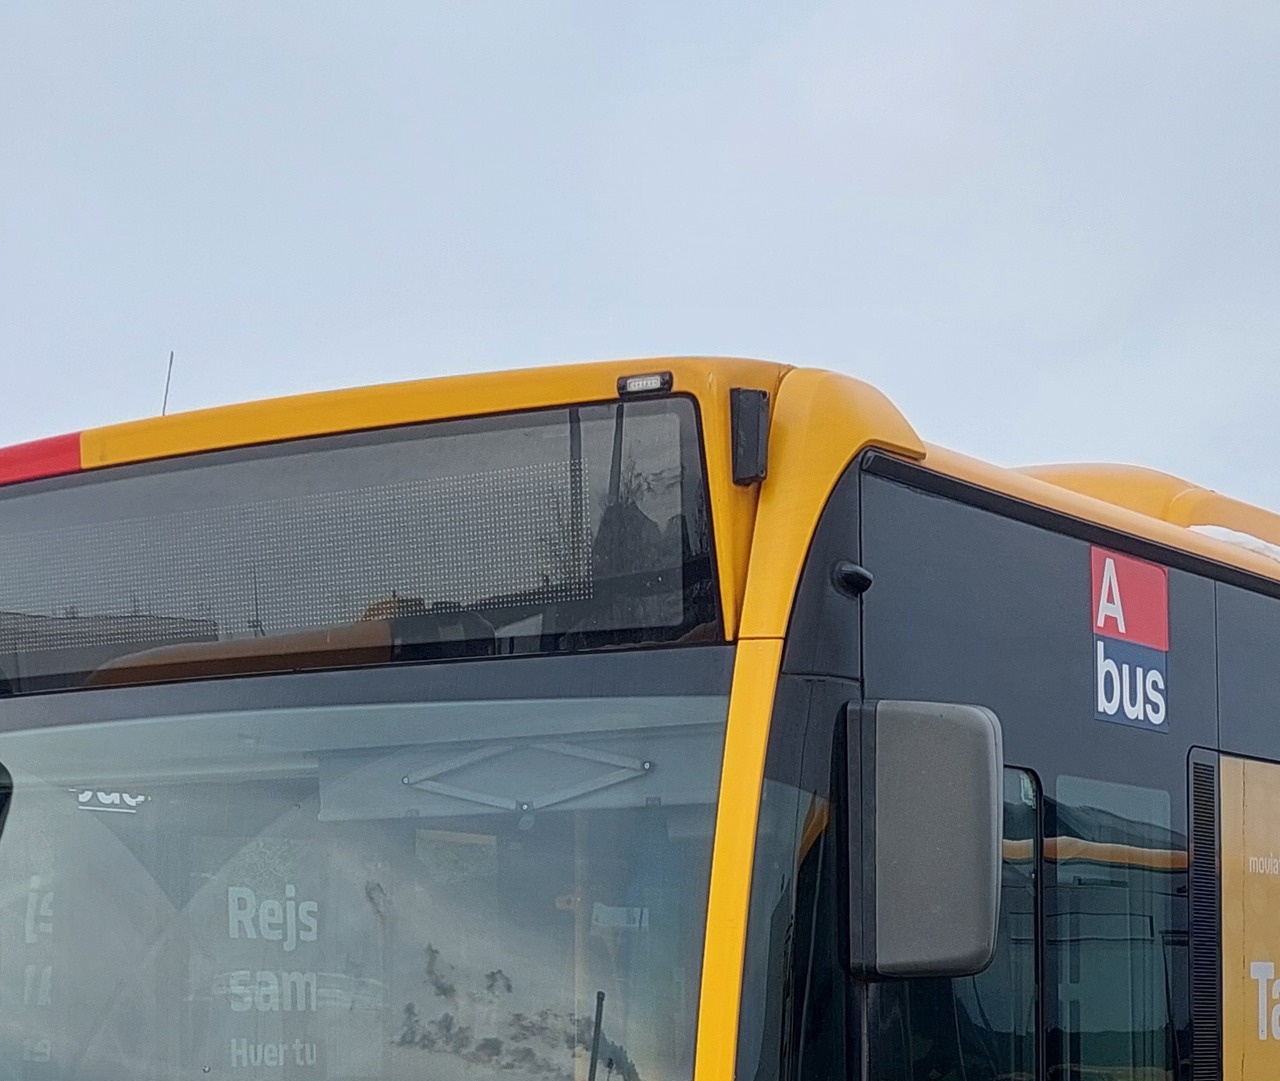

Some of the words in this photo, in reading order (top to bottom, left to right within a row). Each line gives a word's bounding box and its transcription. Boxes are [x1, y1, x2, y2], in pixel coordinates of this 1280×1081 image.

[1097, 557, 1126, 634] A
[1096, 640, 1166, 725] bus
[228, 885, 318, 951] Rejs
